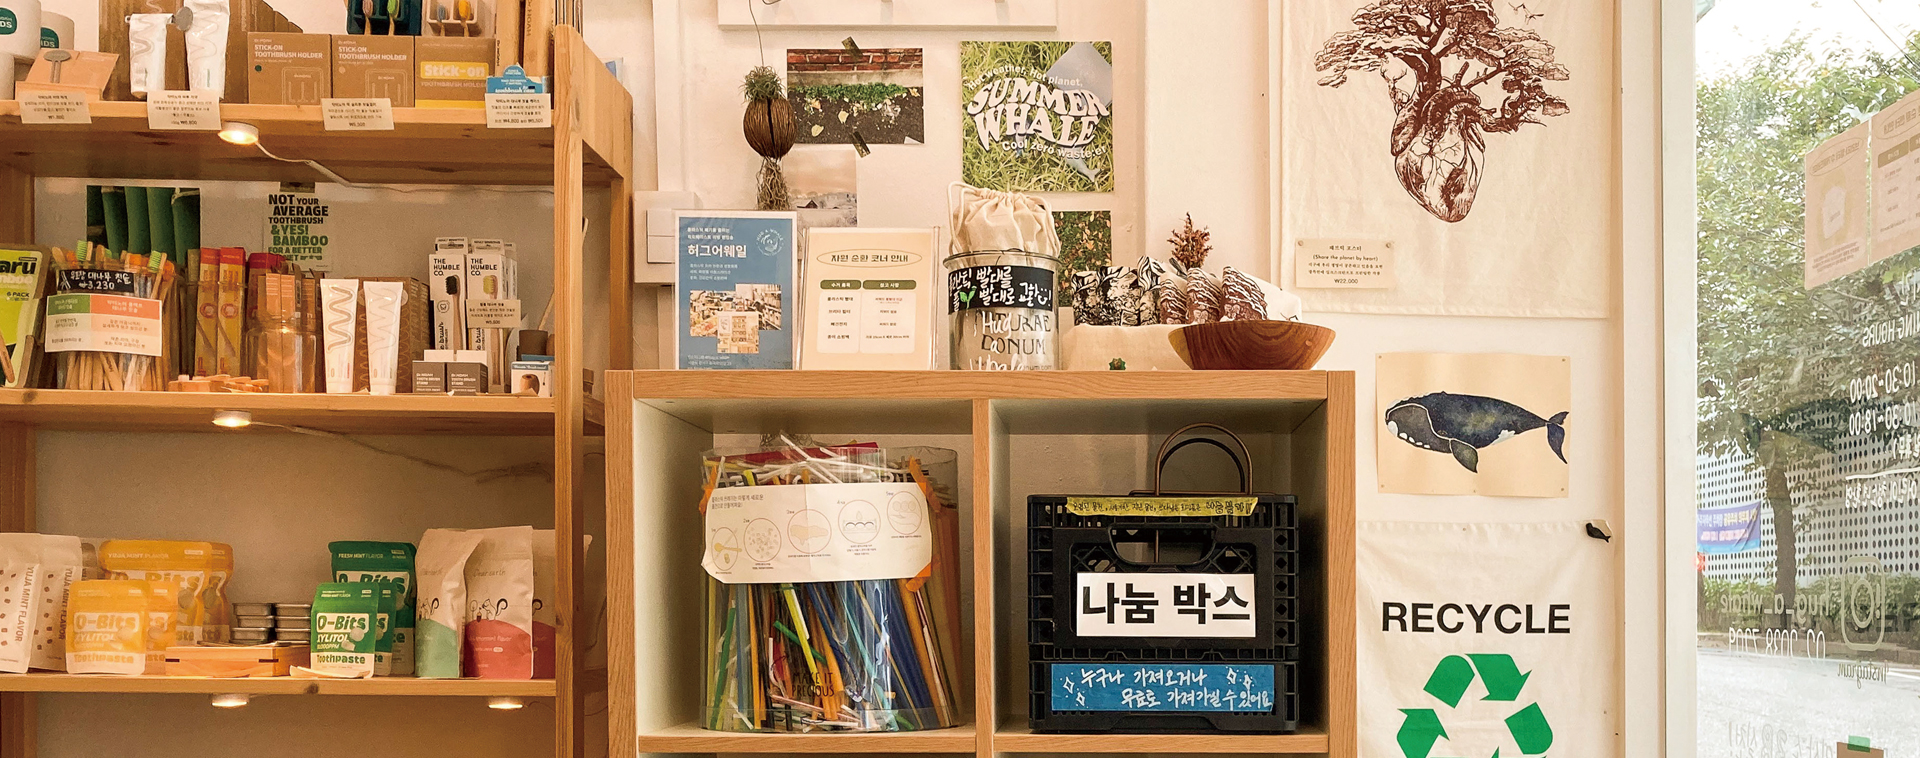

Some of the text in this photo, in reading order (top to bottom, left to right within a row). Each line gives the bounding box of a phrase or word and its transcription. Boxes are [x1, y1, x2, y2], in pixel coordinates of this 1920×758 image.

[255, 51, 297, 59] TOOTHBRUSH
[338, 53, 381, 61] TOOTHBRUSH
[424, 64, 485, 78] Stick-on
[967, 77, 986, 93] Hot
[1029, 68, 1046, 81] Hot
[965, 77, 1109, 117] SUMMER
[973, 102, 1100, 152] WHALE
[1001, 140, 1028, 154] Cool
[1028, 143, 1055, 159] zero
[268, 194, 319, 205] NOT YOUR
[272, 205, 329, 217] AVERAGE
[268, 216, 324, 224] TOOTHBRUSH
[272, 235, 329, 246] BAMBOO
[268, 246, 284, 254] FOR
[292, 246, 323, 254] BETTER
[687, 244, 747, 258] 허그어웨일
[891, 254, 909, 262] 안내
[975, 265, 1013, 290] 빨대를
[979, 284, 1016, 306] 빨대로
[983, 311, 1012, 339] Hug
[981, 334, 1046, 355] DONUM
[750, 493, 764, 501] 새로운
[65, 568, 73, 586] YUJA
[14, 567, 35, 642] YUJA MINT FLAVOR
[1082, 582, 1251, 625] 나눔 박스
[58, 606, 68, 640] FLAVOR
[74, 612, 139, 632] O-Bits
[317, 615, 366, 630] O-Bits
[1381, 601, 1571, 634] RECYCLE
[74, 652, 135, 665] Toothpaste
[316, 654, 366, 665] Toothpaste
[792, 672, 834, 684] MAKE IT
[1080, 667, 1208, 688] 누구나 가져오거나
[791, 684, 835, 698] PRECIOUS
[1121, 686, 1274, 712] 무료로 가져가실 수 있어요
